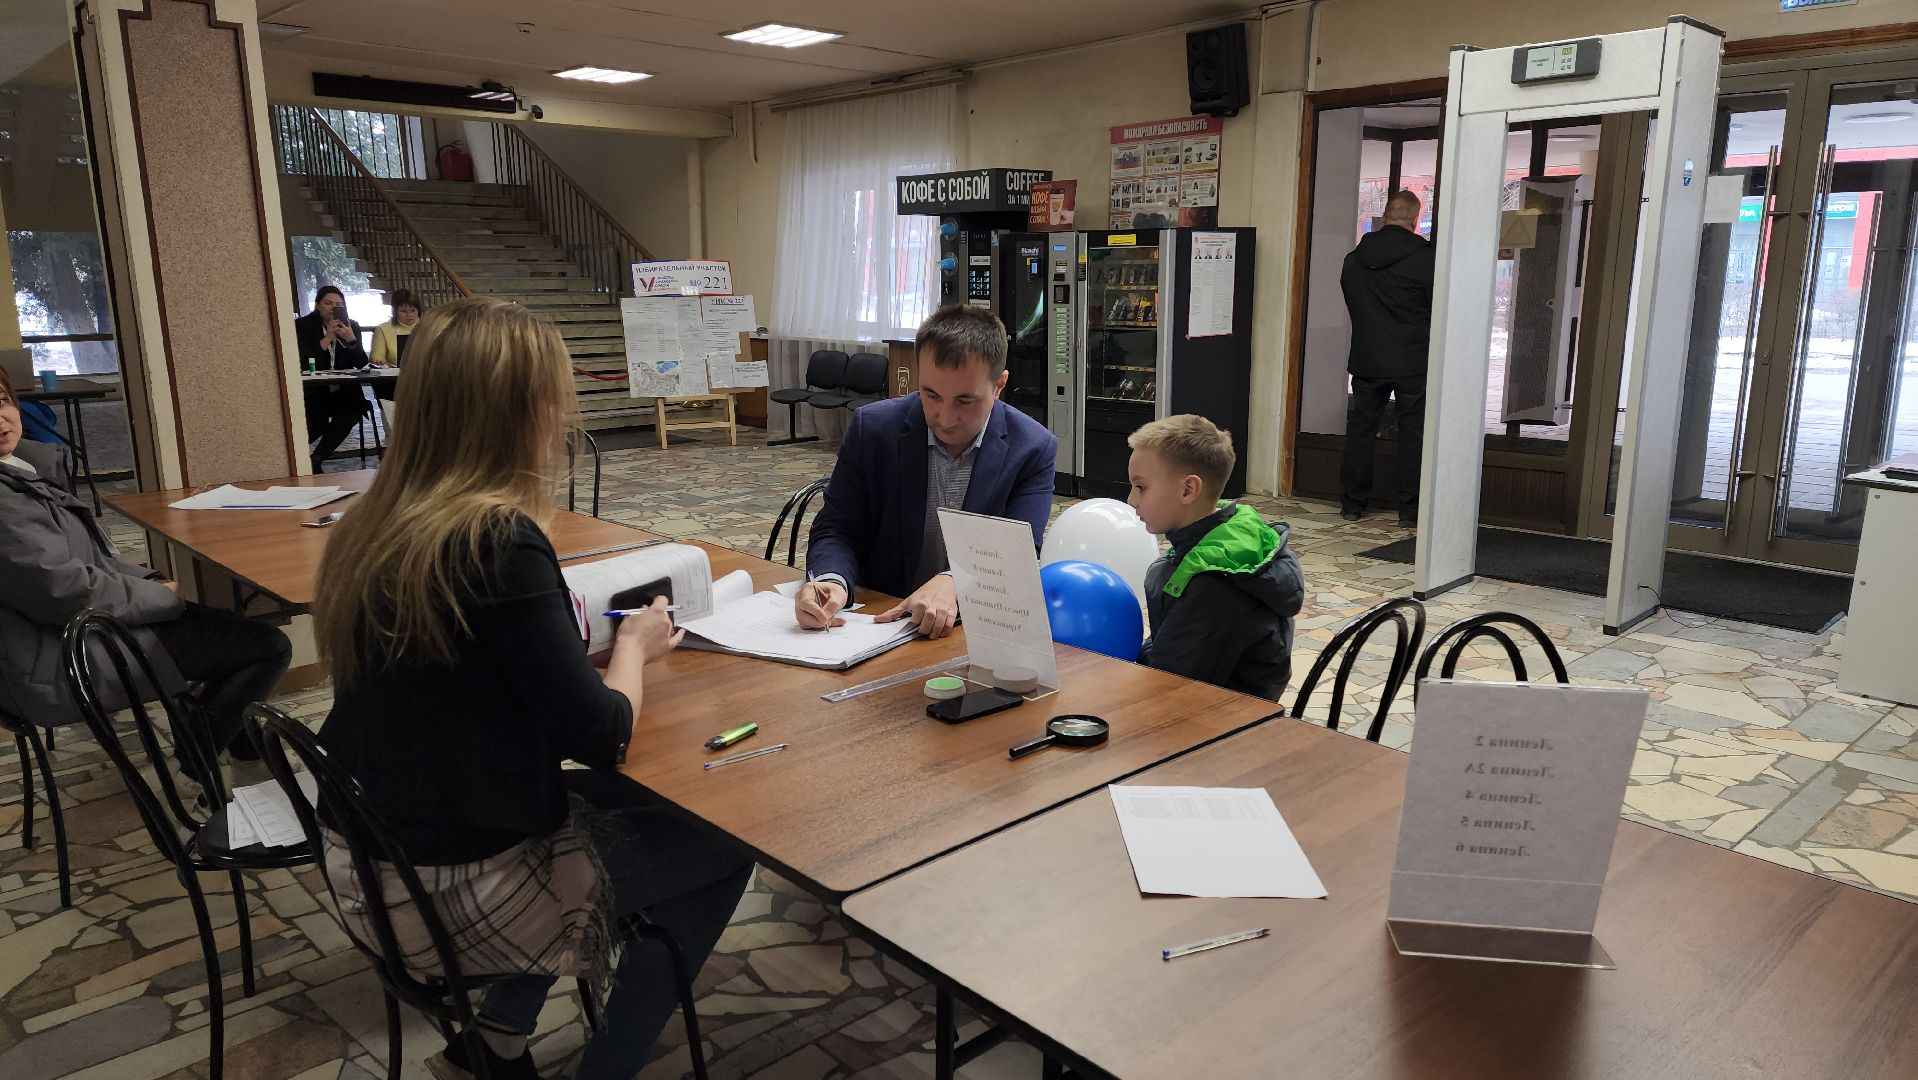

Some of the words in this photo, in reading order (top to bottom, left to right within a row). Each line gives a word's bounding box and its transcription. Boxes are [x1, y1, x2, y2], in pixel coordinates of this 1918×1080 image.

[1158, 118, 1208, 136] БЕЗОПАСНОСТЬ
[902, 179, 935, 204] КОФЕ
[937, 179, 946, 202] С
[948, 170, 990, 202] СОБОЙ
[1032, 192, 1049, 204] КОФЕ
[636, 264, 694, 273] ИЗБИРАТЕЛЬНЫЙ
[704, 276, 728, 290] 221
